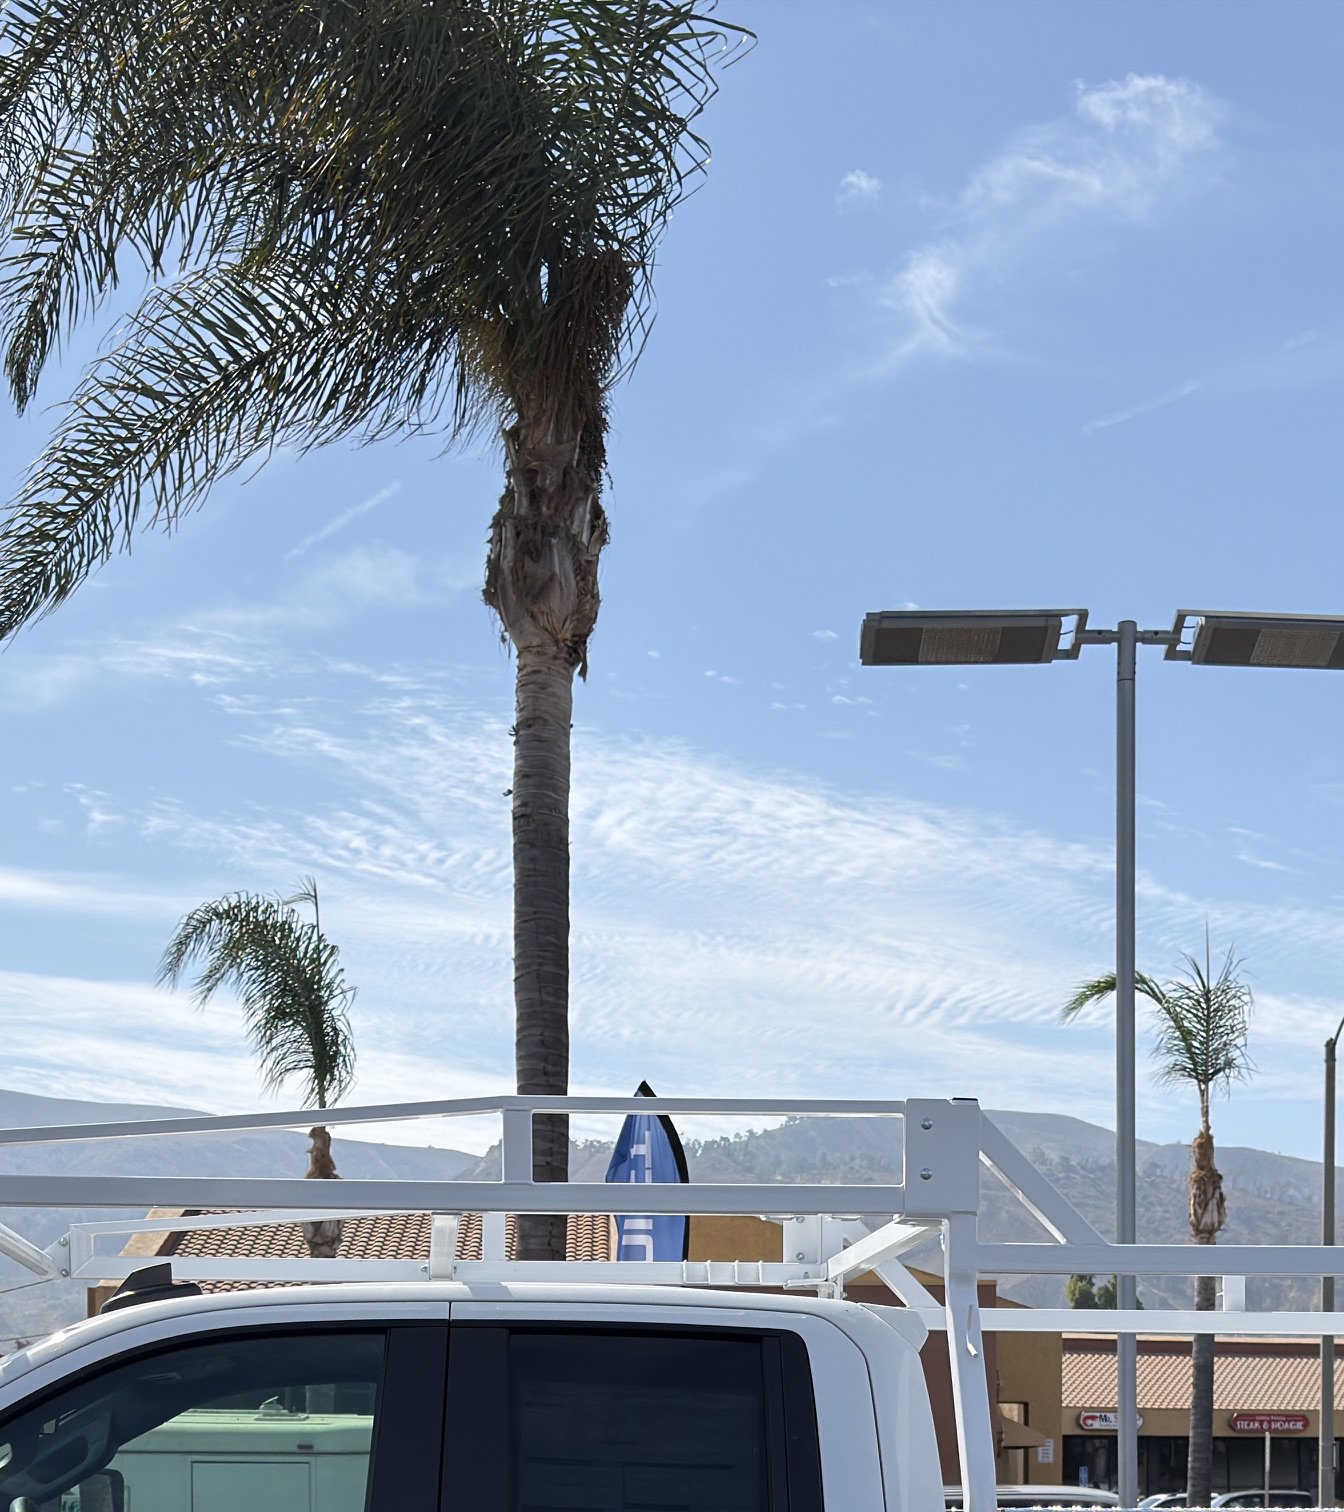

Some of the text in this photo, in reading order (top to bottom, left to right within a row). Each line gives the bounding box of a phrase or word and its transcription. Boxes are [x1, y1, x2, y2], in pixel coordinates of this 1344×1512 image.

[1236, 1421, 1304, 1430] STEAK & HOAGIE
